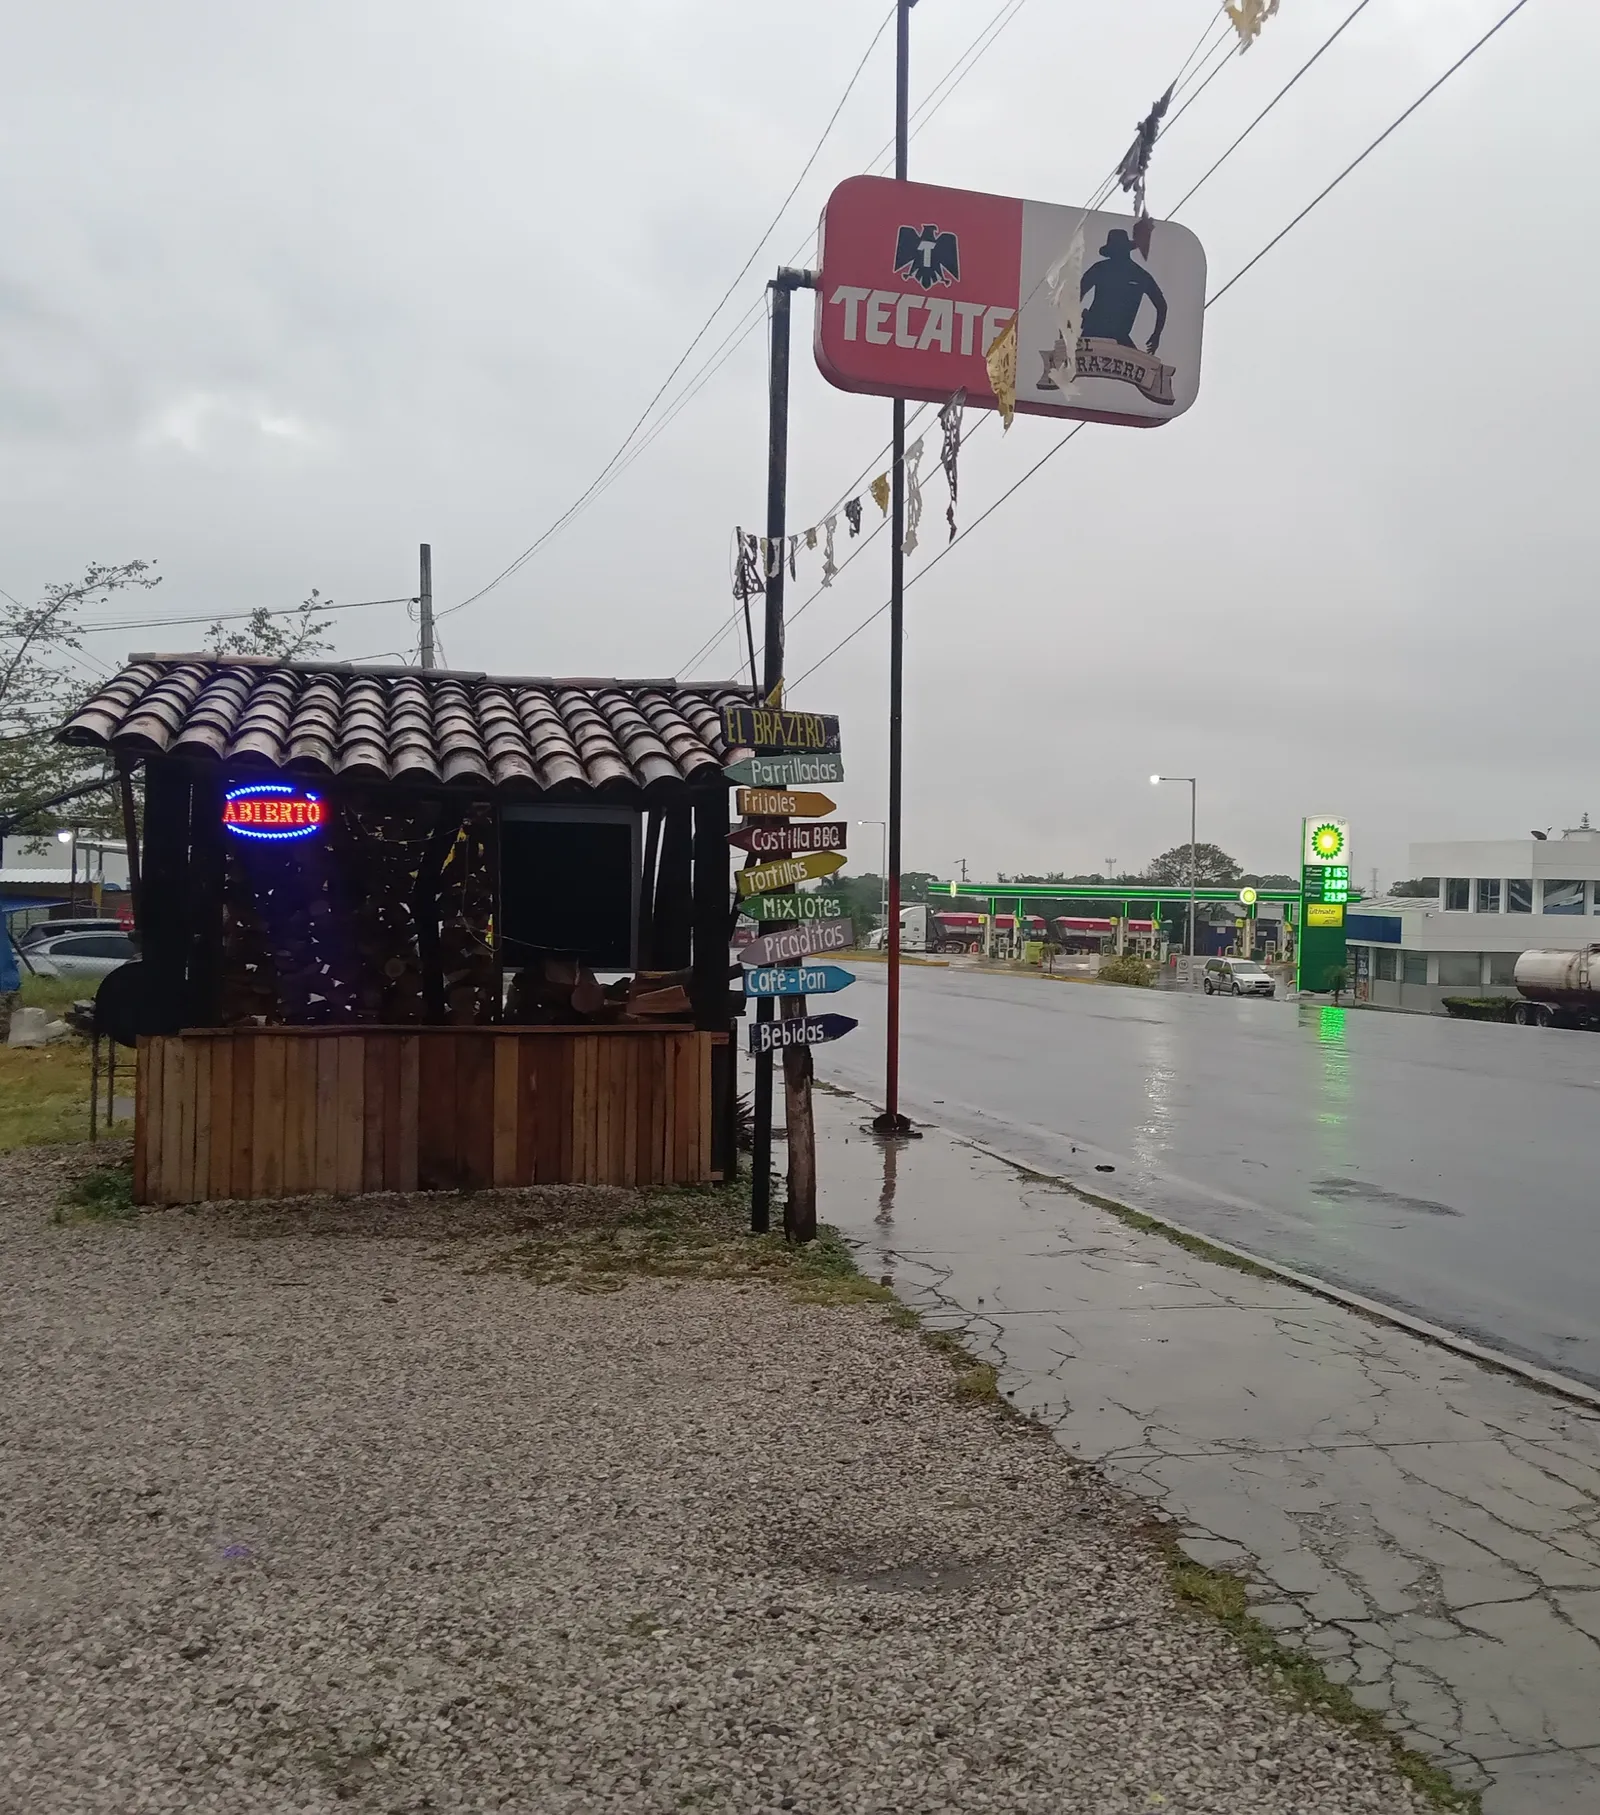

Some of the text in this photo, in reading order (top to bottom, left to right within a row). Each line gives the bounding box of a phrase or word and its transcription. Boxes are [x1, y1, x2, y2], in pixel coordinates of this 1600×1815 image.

[829, 285, 1017, 358] TECATE
[1063, 355, 1146, 383] RAZERO
[726, 708, 826, 748] EL BRAZERO
[751, 758, 837, 784] Parrilladas
[223, 801, 321, 823] ABIERTO
[744, 791, 796, 813] Frijoles
[752, 828, 810, 851] Costilla
[745, 861, 808, 892] Tortillas
[764, 924, 845, 962] Picaditas
[760, 1019, 824, 1051] Bebidas
